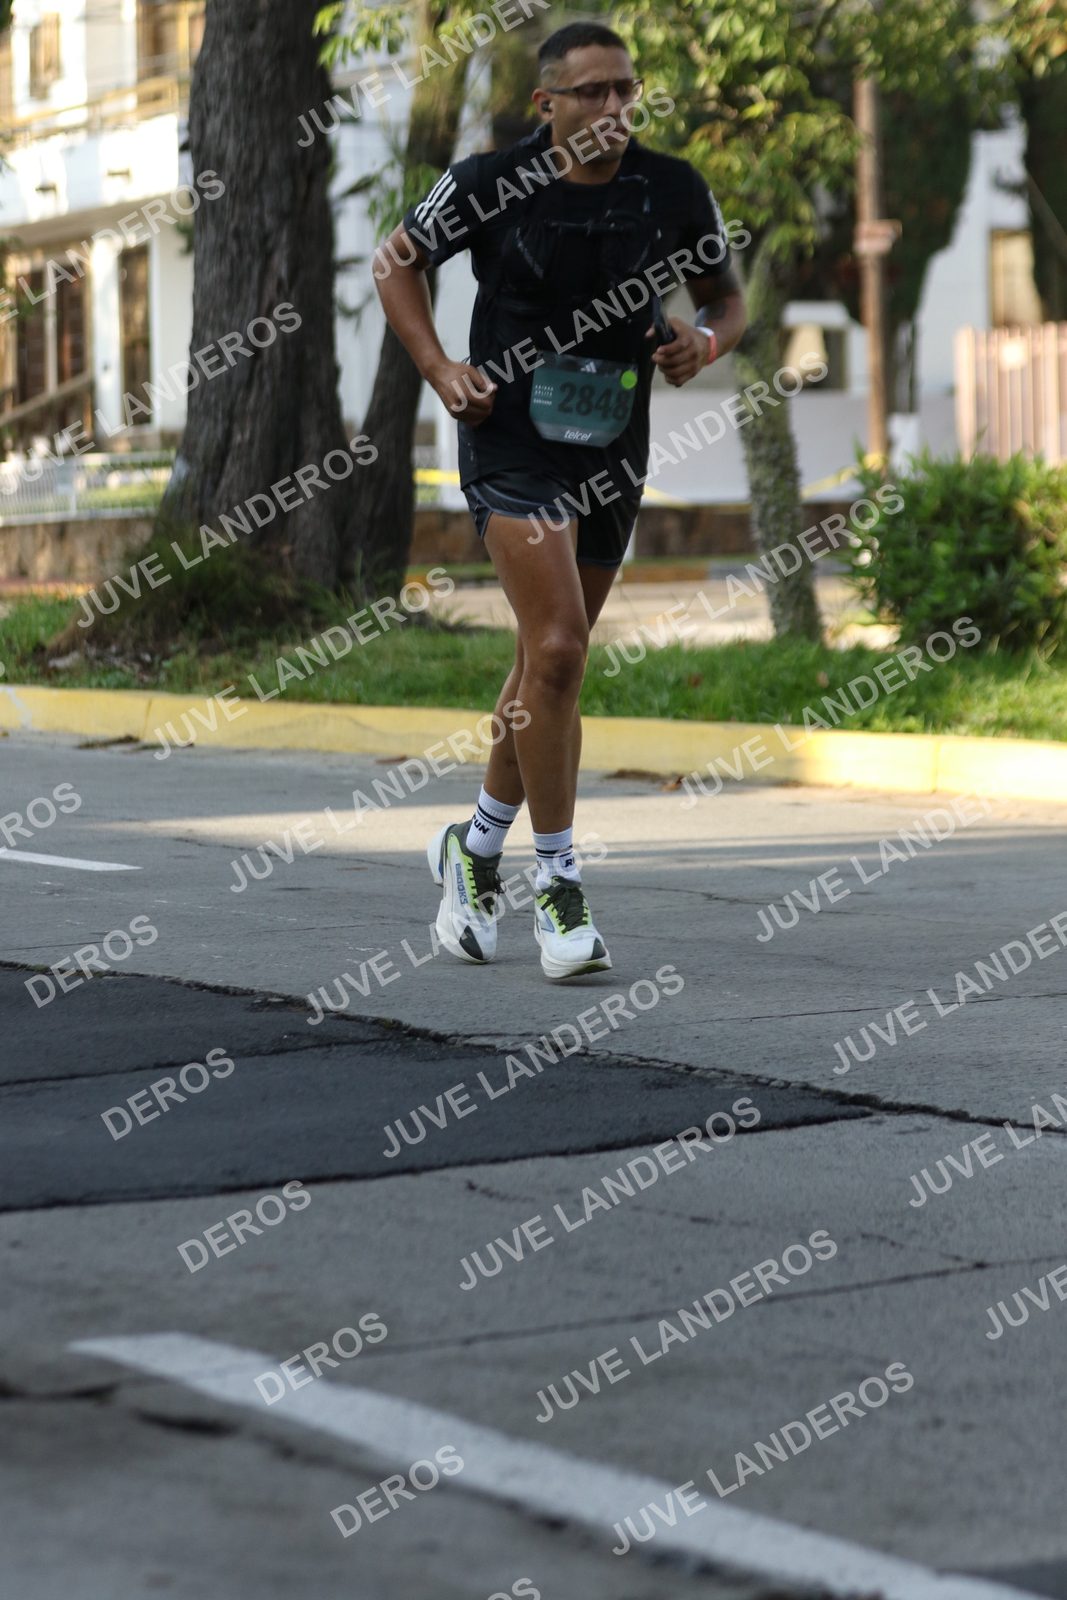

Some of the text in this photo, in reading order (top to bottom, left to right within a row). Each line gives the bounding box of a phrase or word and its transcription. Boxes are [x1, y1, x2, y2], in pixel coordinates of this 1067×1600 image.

[557, 381, 631, 420] 2848
[563, 429, 592, 442] telcel
[473, 814, 490, 835] UN
